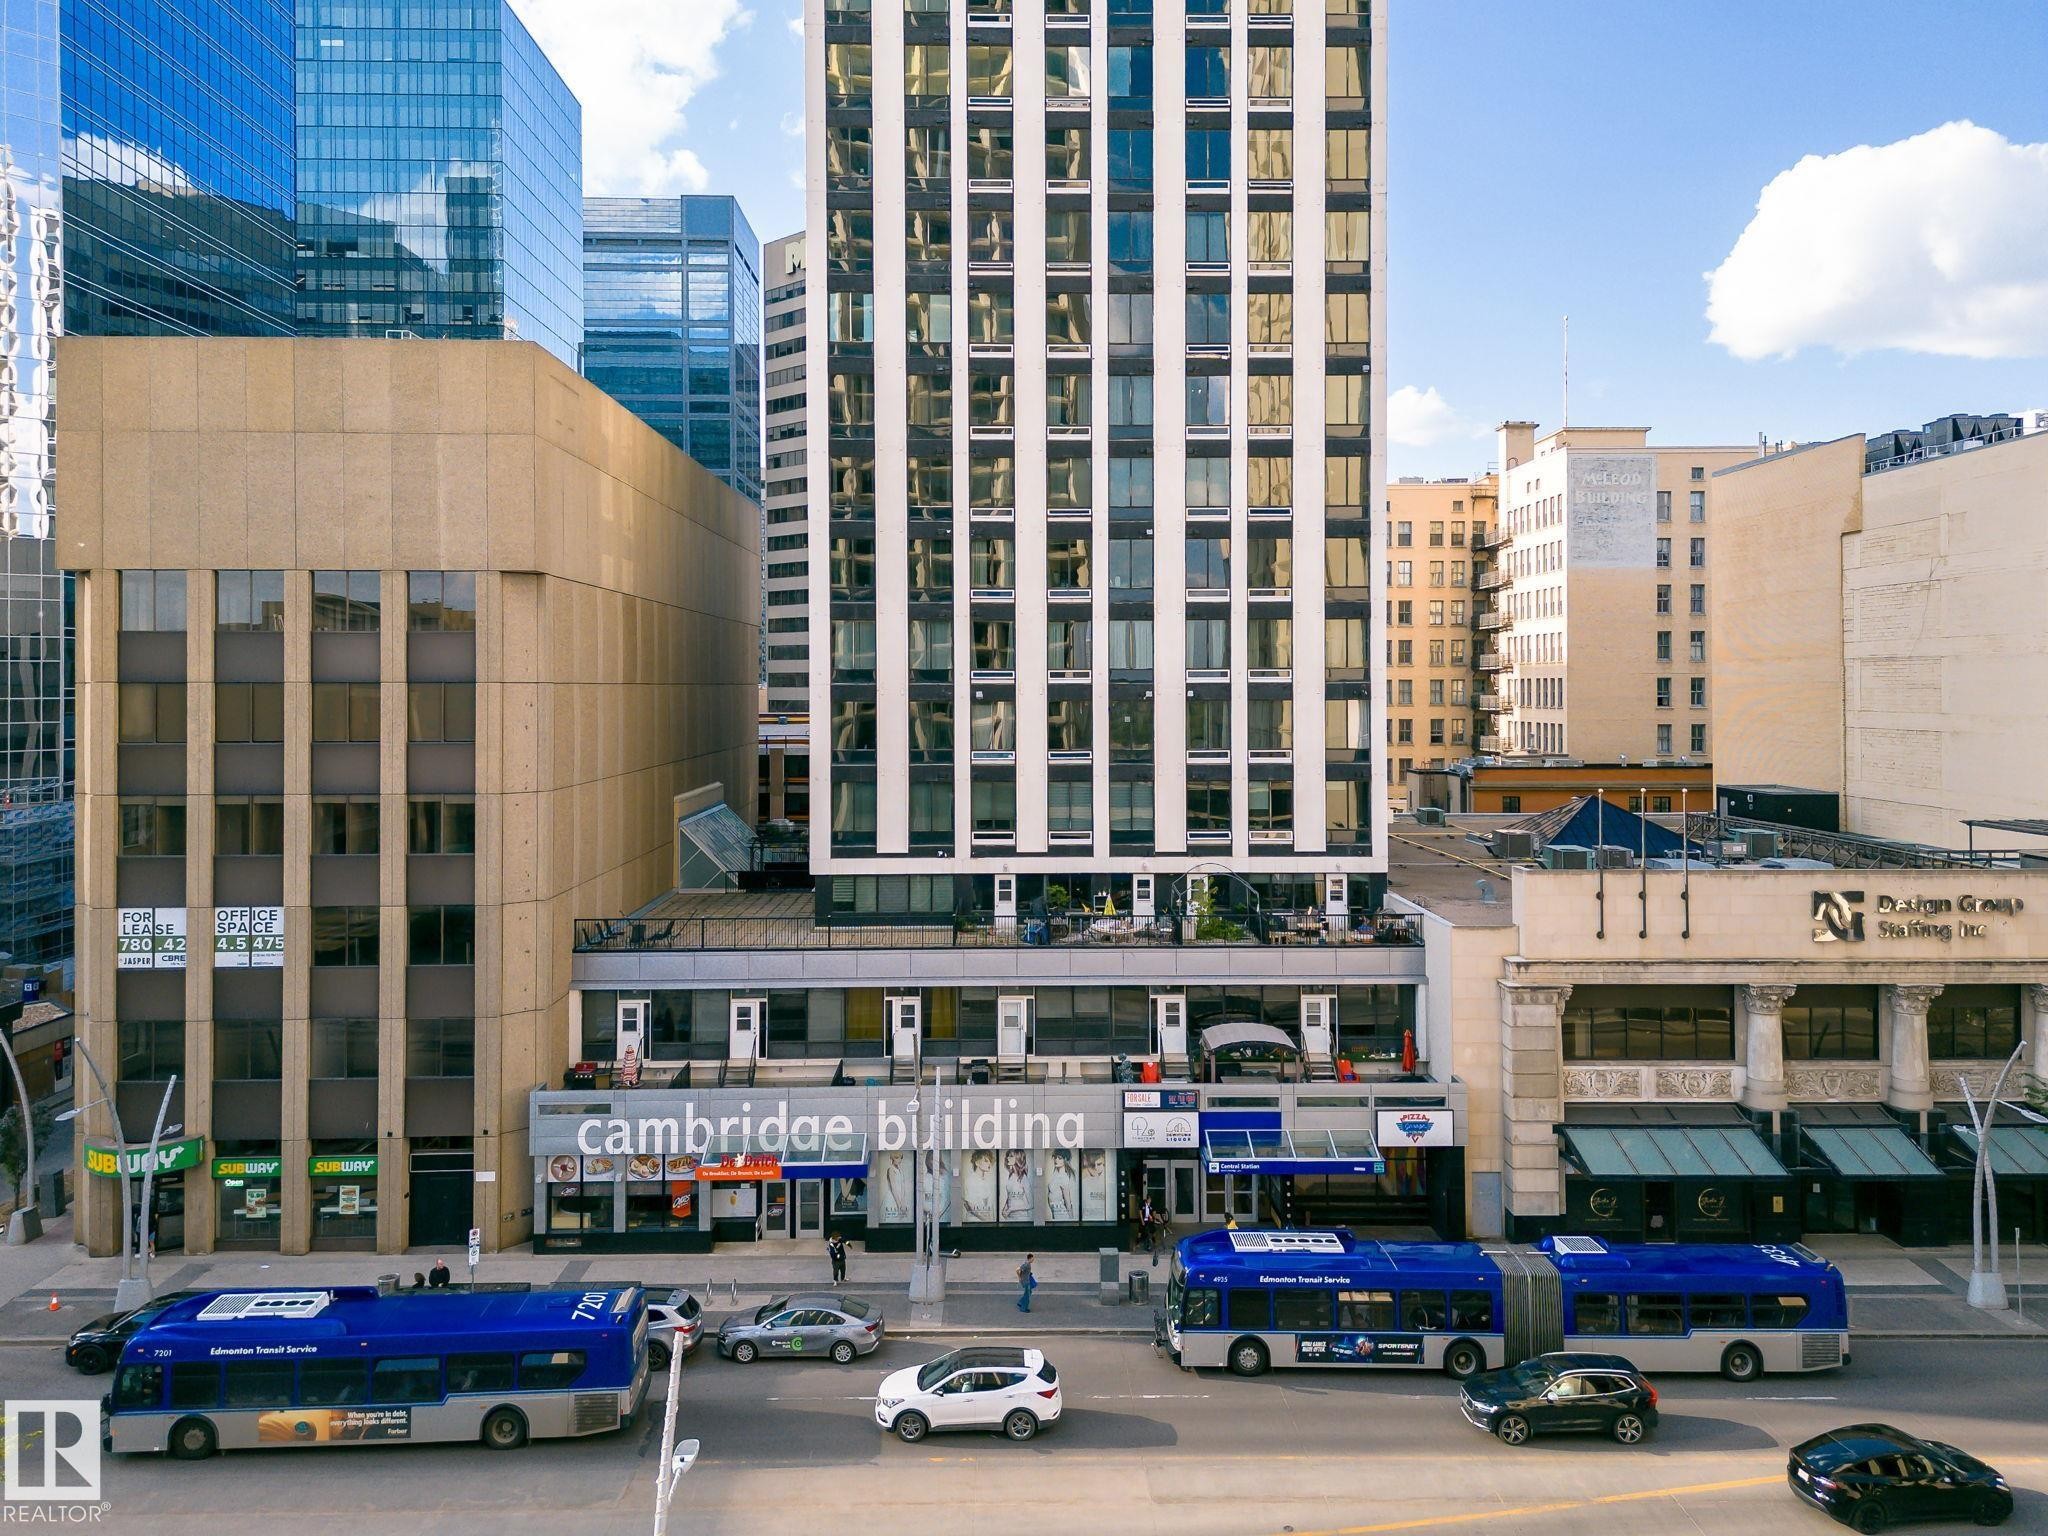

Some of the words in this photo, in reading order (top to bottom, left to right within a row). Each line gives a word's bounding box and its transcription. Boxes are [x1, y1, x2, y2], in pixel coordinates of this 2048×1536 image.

[1575, 489, 1650, 505] BUILDING
[1877, 895, 1951, 917] Design
[1957, 894, 2024, 917] Group
[122, 912, 152, 923] FOR
[217, 909, 278, 922] OFFICE
[122, 924, 174, 935] LEASE
[217, 922, 274, 934] SPACE
[1878, 919, 1952, 939] Staffing
[1959, 920, 1987, 938] Inc
[123, 957, 151, 965] JASPER
[161, 954, 186, 962] CBRE
[1127, 1093, 1137, 1103] FOR
[1138, 1093, 1152, 1103] SALE
[1402, 1113, 1428, 1121] PIZZA
[577, 1101, 853, 1155] cambridge
[878, 1098, 1085, 1150] building
[88, 1145, 185, 1174] SUBWAY
[217, 1161, 279, 1175] SUBWAY
[314, 1159, 375, 1174] SUBWAY
[225, 1179, 244, 1187] Open
[1259, 1275, 1297, 1283] Edmonton
[1323, 1276, 1351, 1284] Service
[571, 1292, 609, 1321] 7201
[154, 1349, 172, 1357] 7201
[210, 1347, 254, 1355] Edmonton
[255, 1346, 285, 1354] Transit
[286, 1345, 318, 1353] Service
[347, 1411, 365, 1419] When
[330, 1419, 363, 1427] everything
